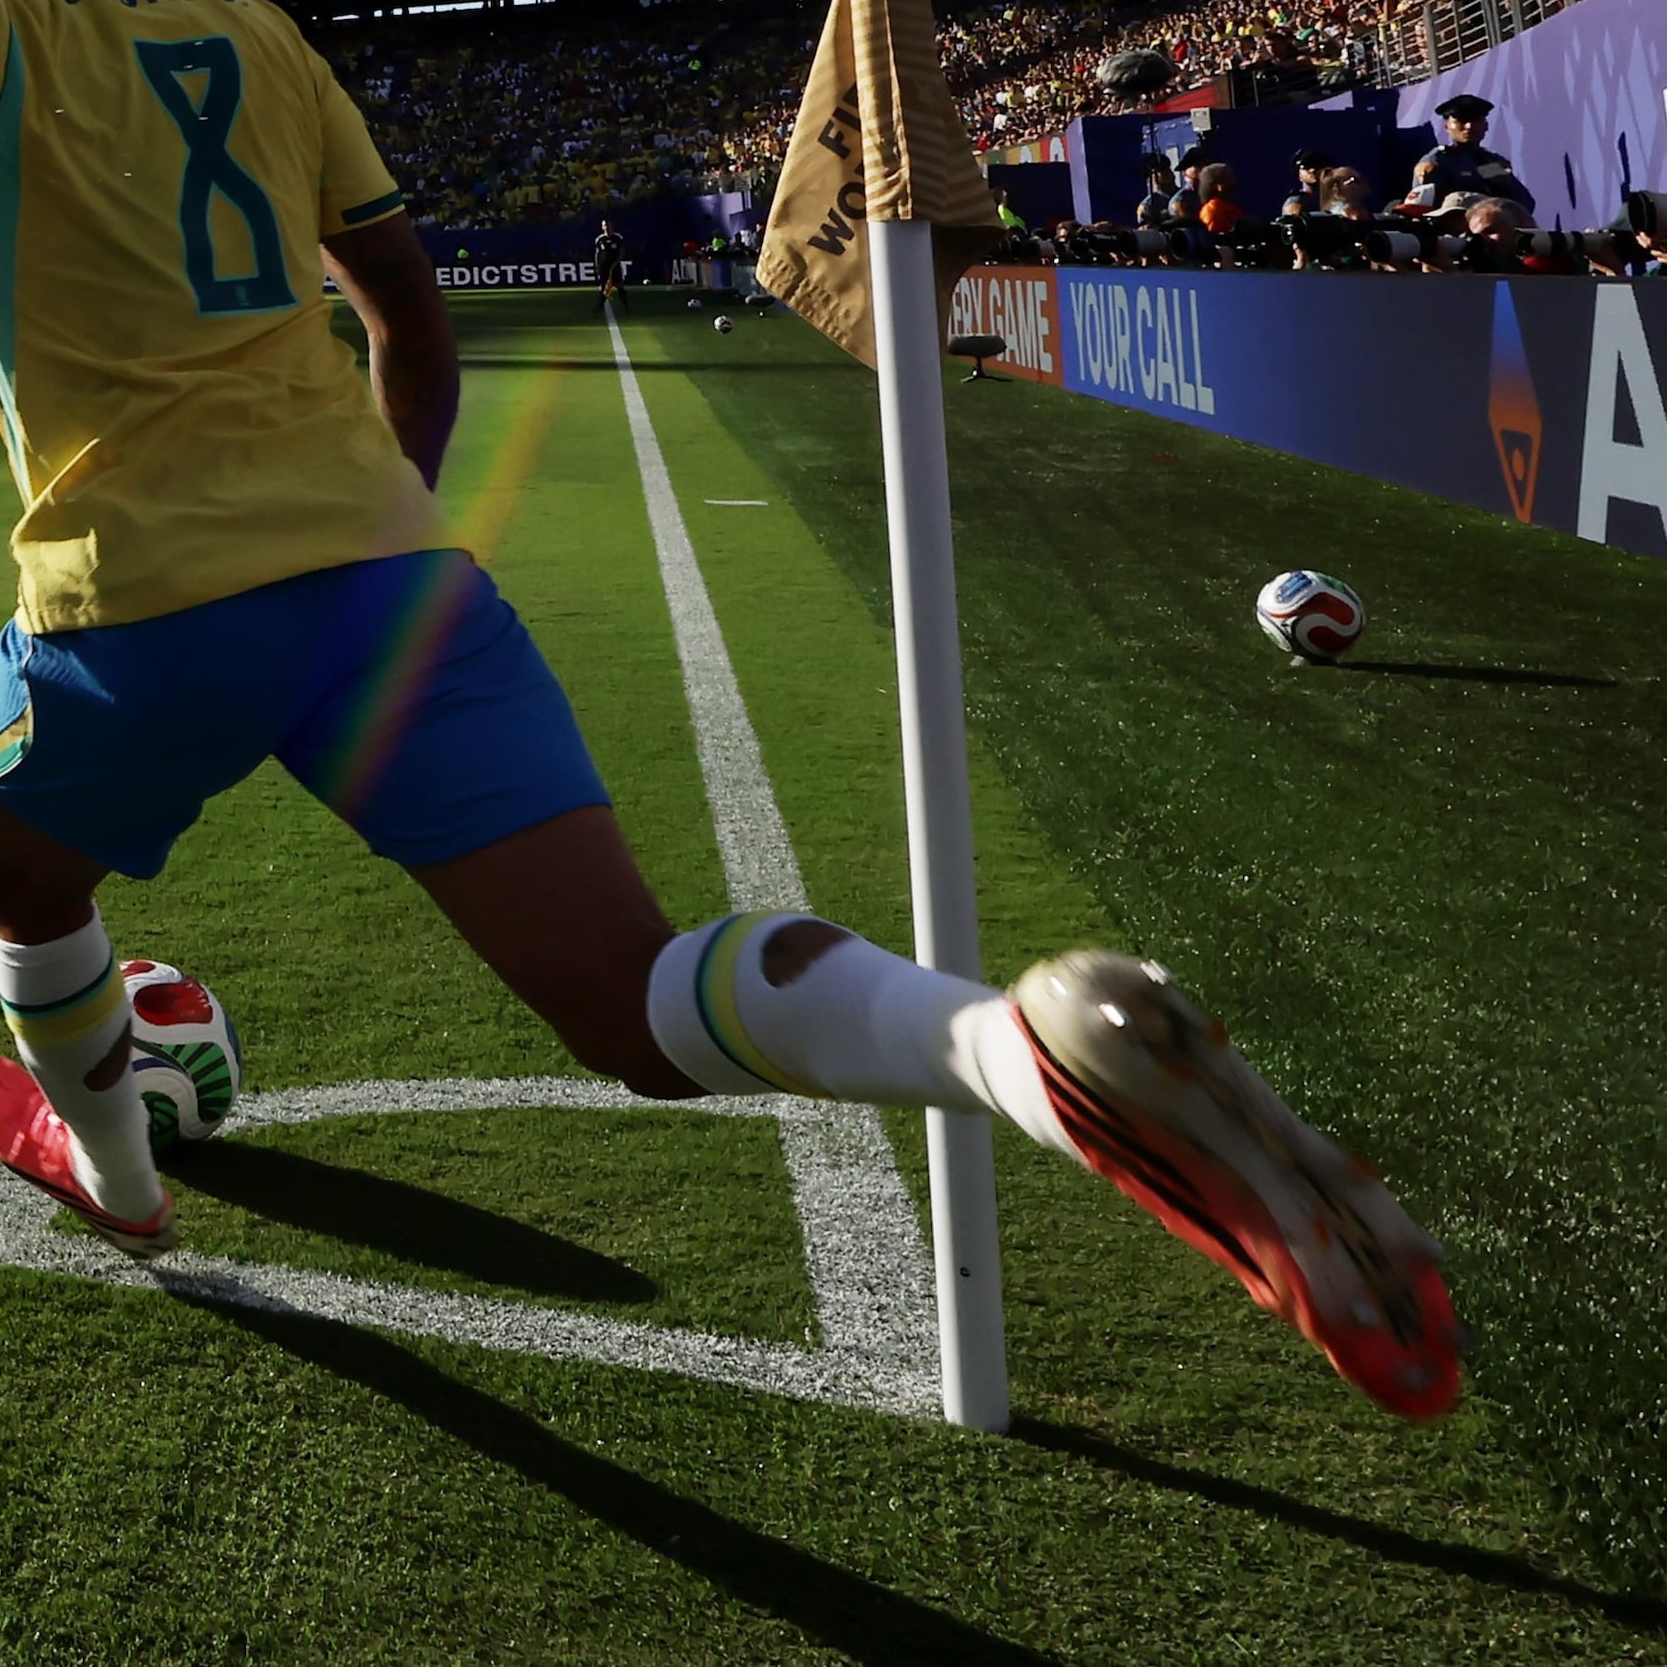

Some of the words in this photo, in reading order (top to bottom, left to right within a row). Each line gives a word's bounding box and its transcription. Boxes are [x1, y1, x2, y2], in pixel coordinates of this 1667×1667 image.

[134, 36, 304, 319] 8
[435, 260, 633, 287] EDICTSTRET
[989, 276, 1054, 374] GAME
[1069, 281, 1135, 396] YOUR
[1137, 283, 1216, 417] CALL
